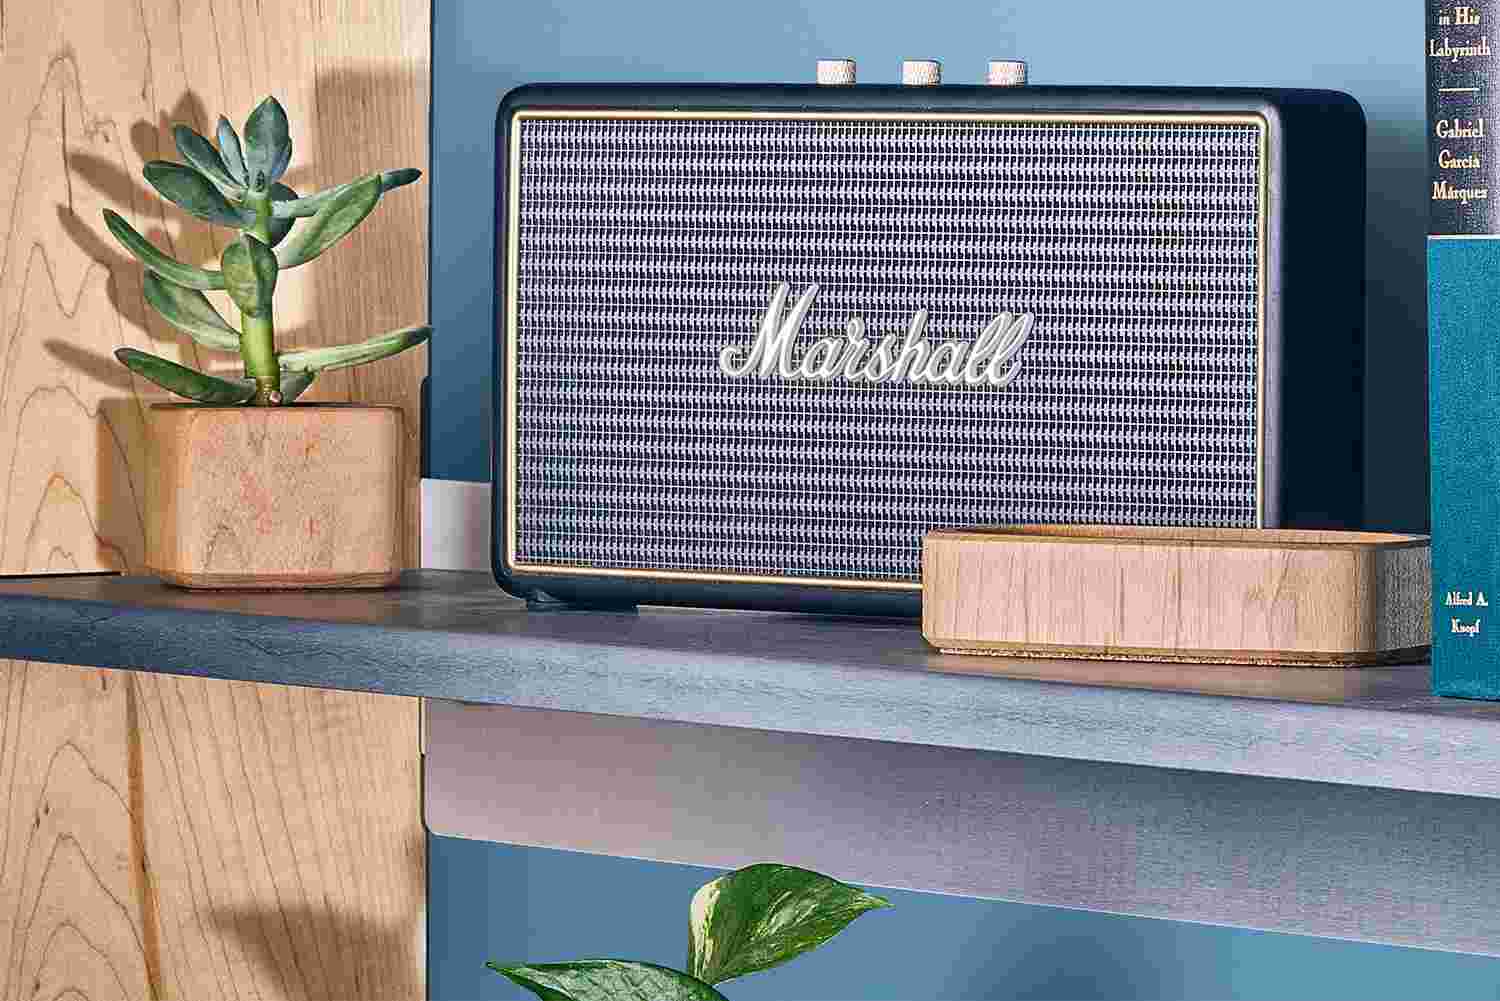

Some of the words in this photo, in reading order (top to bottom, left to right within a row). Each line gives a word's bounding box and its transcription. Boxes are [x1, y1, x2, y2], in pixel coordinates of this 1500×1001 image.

[1438, 8, 1452, 25] in
[1455, 7, 1481, 25] His
[1429, 36, 1491, 63] Labyrinth
[1435, 118, 1484, 138] Gabriel
[719, 281, 1035, 386] Marshall
[1450, 618, 1481, 638] Knopf
